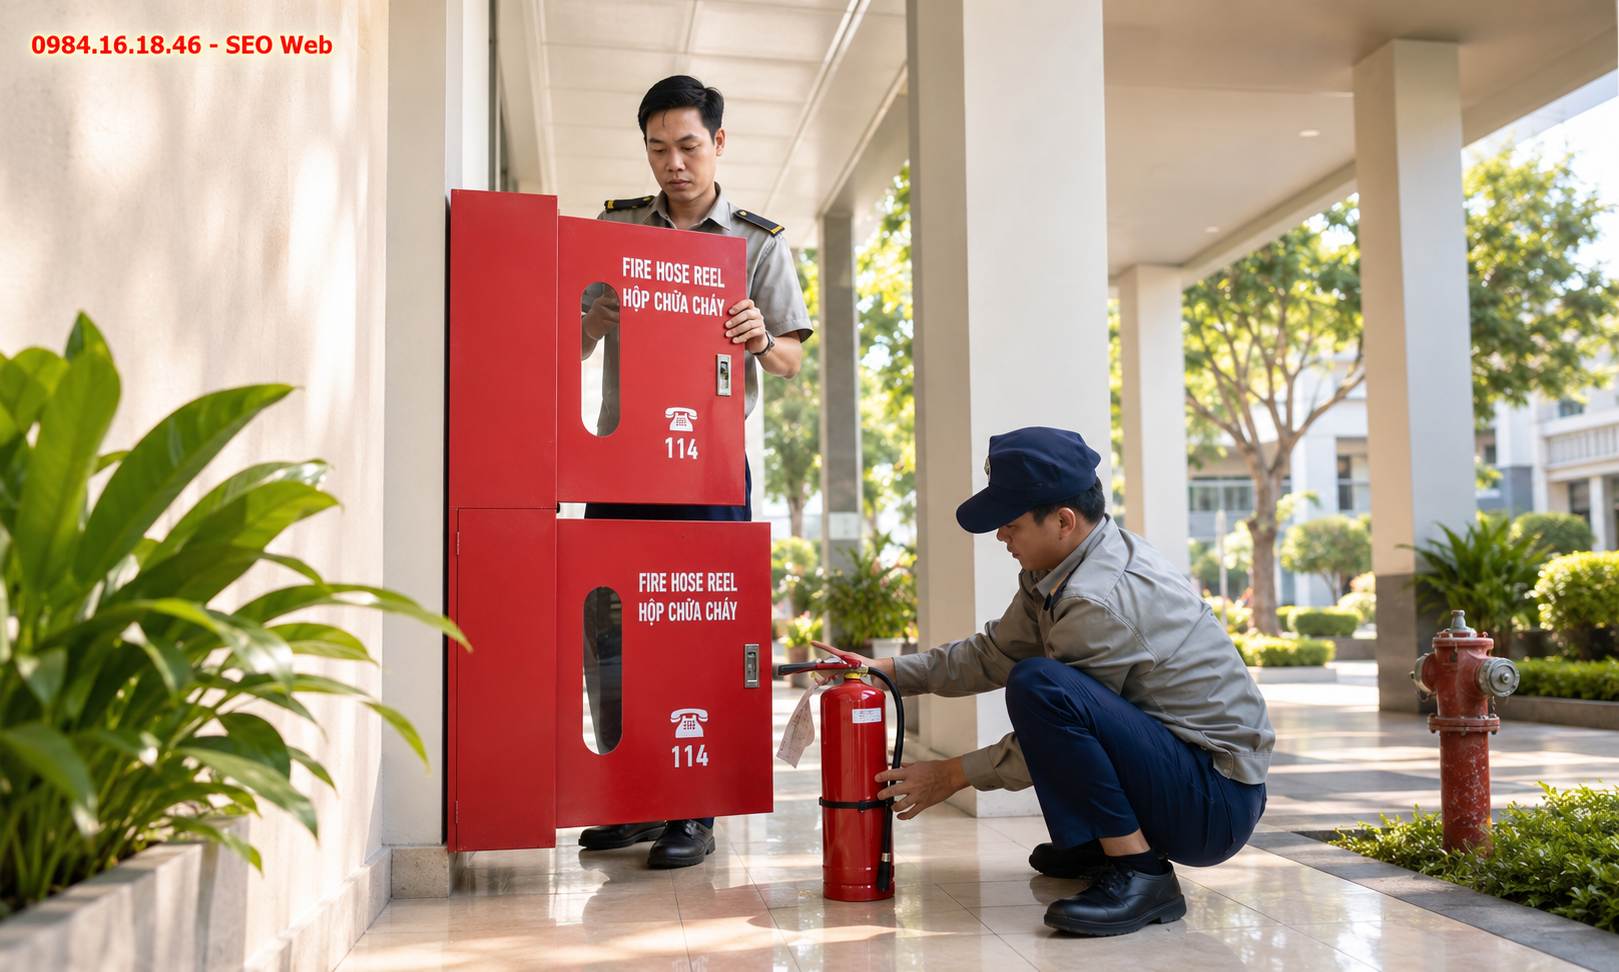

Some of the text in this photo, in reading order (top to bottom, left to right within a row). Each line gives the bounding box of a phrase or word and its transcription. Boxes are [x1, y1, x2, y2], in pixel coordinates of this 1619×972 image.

[622, 256, 726, 289] FIRE HOSE REEL
[622, 285, 650, 313] HỘP
[692, 293, 726, 317] CHÁY
[664, 436, 699, 460] 114
[638, 572, 738, 593] FIRE HOSE REEL
[638, 597, 665, 627] HỘP
[705, 596, 738, 621] CHÁY
[671, 744, 709, 768] 114
